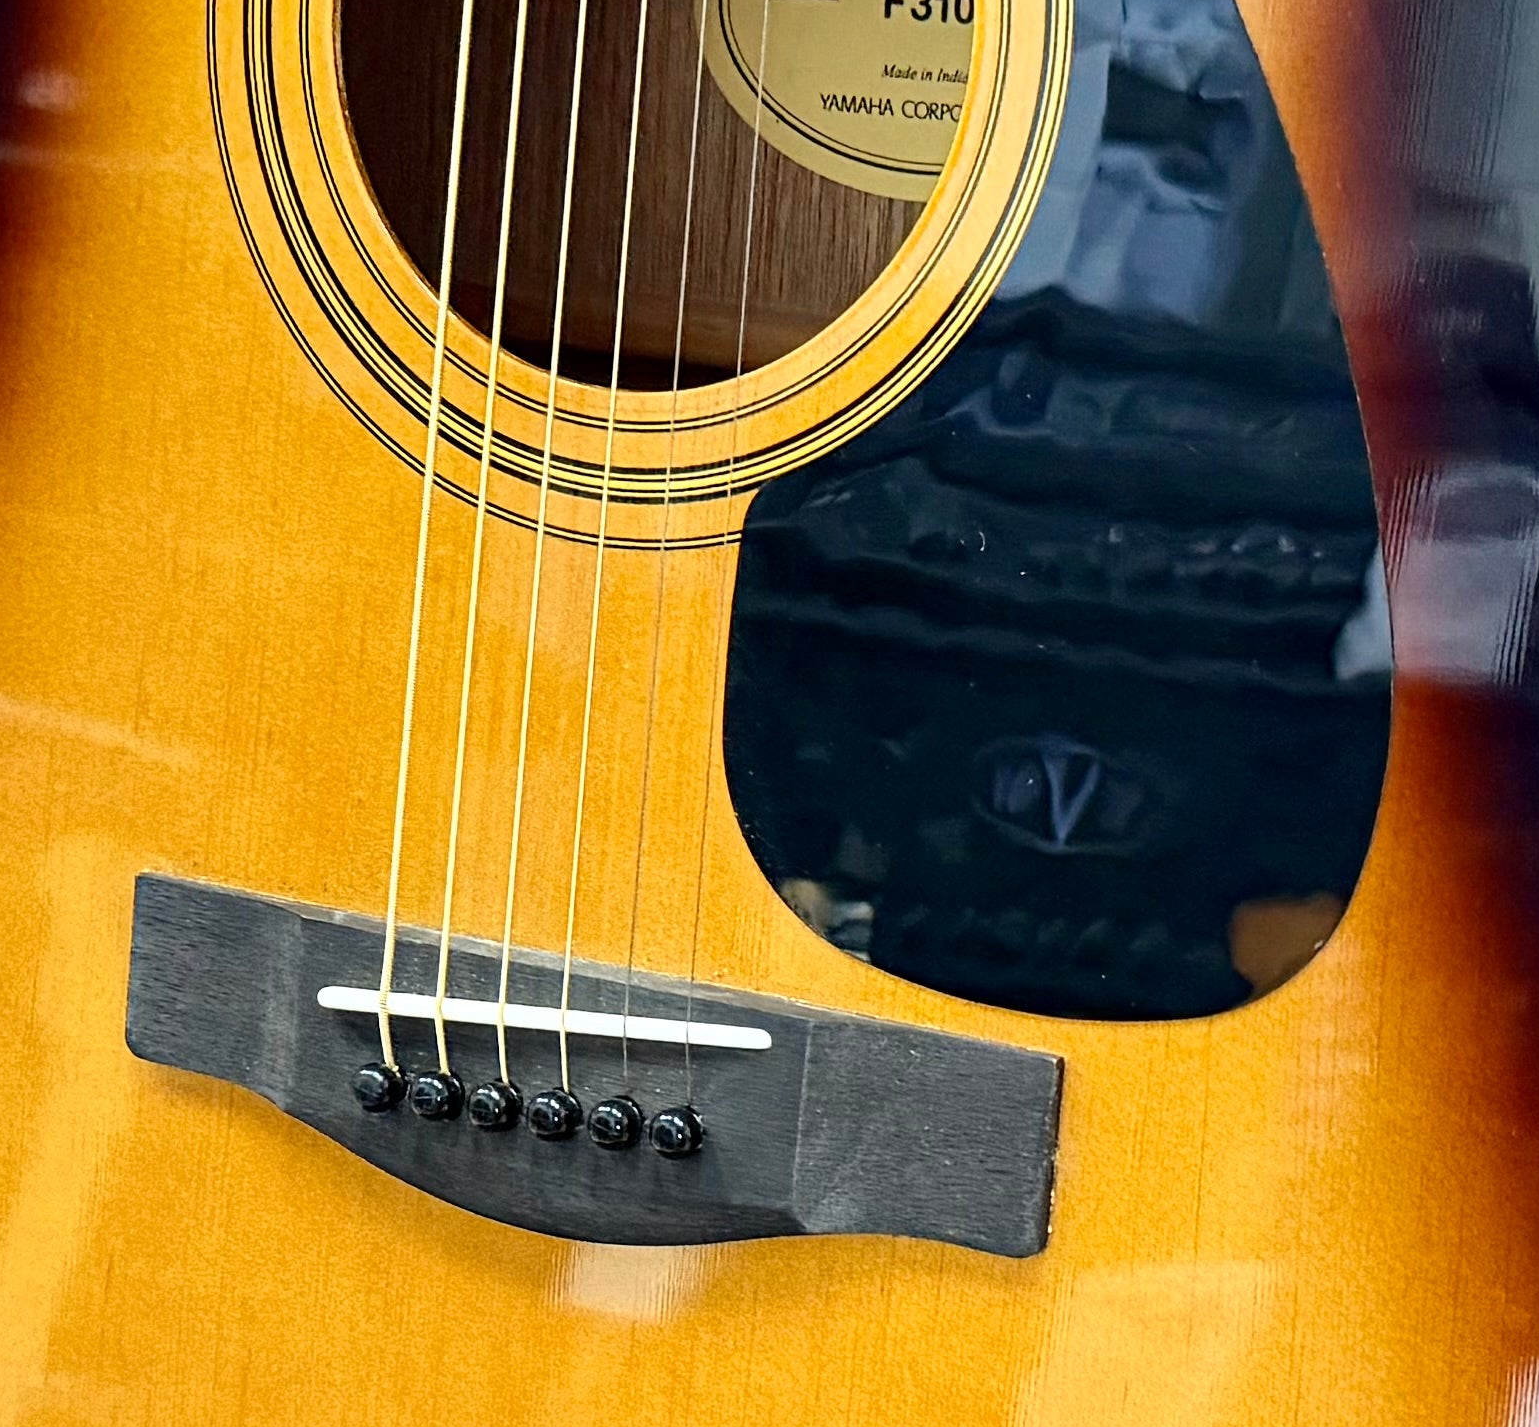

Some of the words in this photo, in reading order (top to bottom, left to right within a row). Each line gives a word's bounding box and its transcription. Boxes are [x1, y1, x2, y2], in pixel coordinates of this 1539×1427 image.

[881, 64, 917, 81] Made
[920, 66, 933, 83] in
[820, 92, 894, 116] YAMAHA
